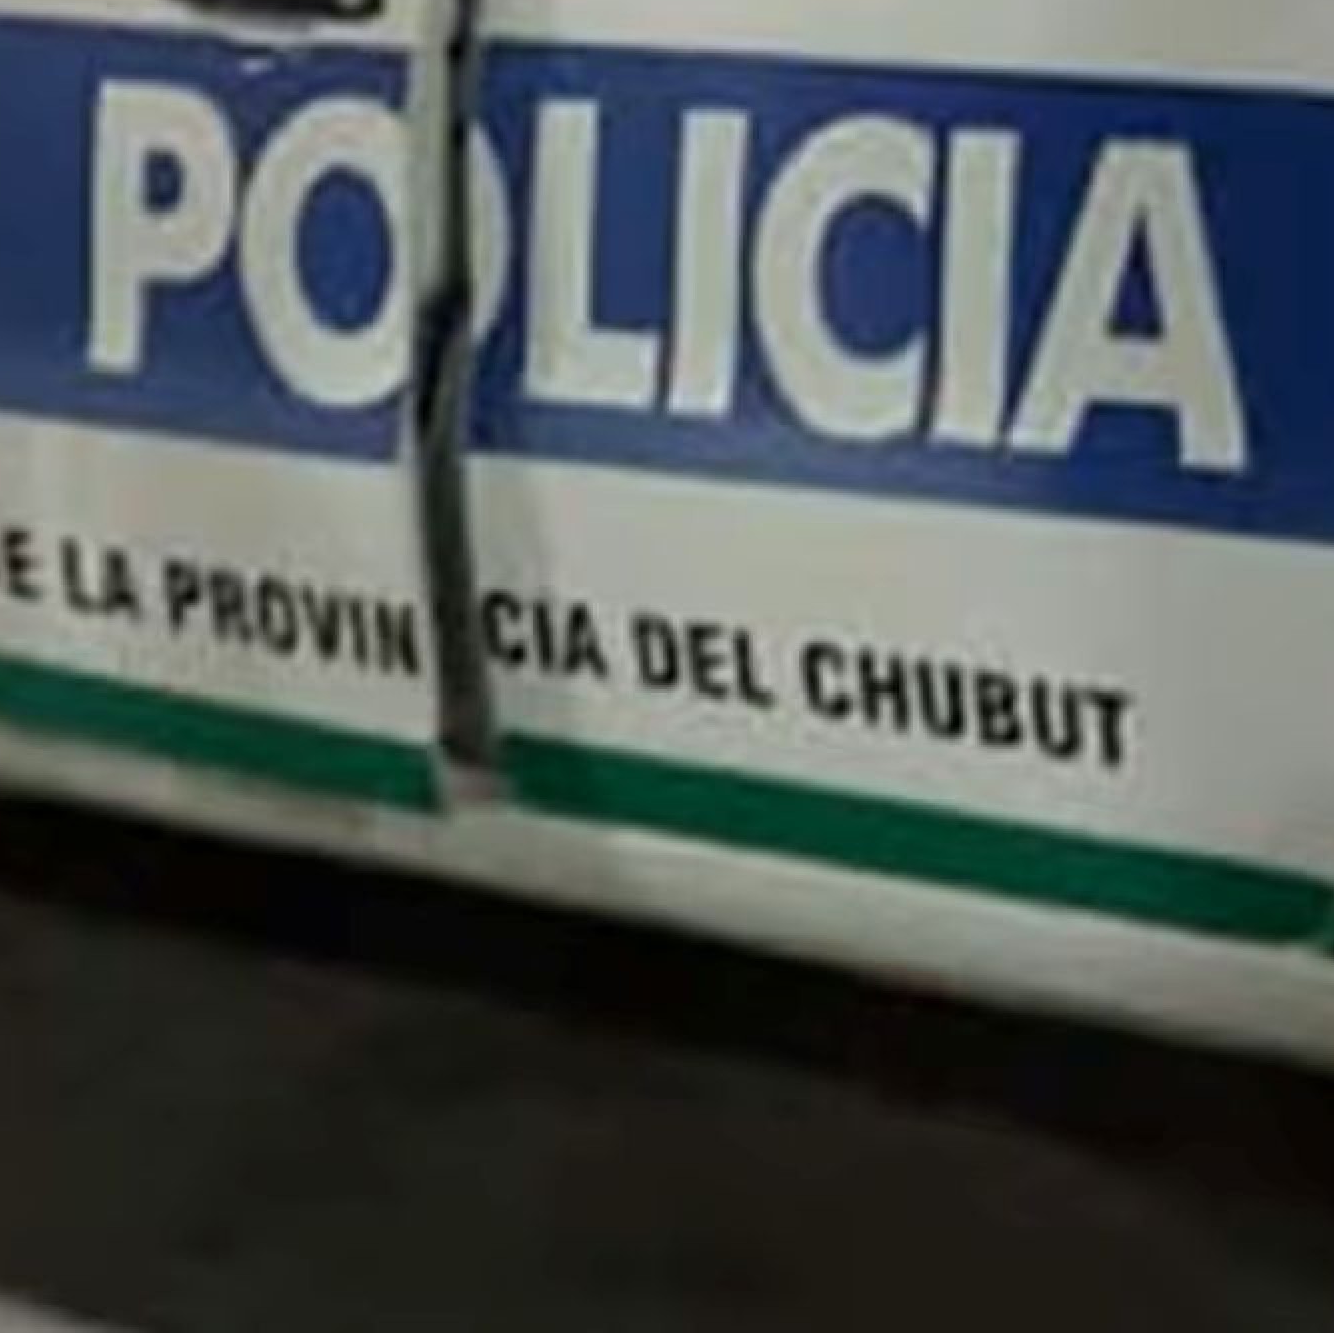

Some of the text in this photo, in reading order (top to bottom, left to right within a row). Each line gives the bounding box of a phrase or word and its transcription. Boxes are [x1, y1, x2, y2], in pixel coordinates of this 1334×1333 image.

[87, 76, 1249, 473] POLICIA
[62, 537, 137, 620] LA
[629, 611, 773, 709] DEL
[797, 640, 1129, 767] CHUBUT
